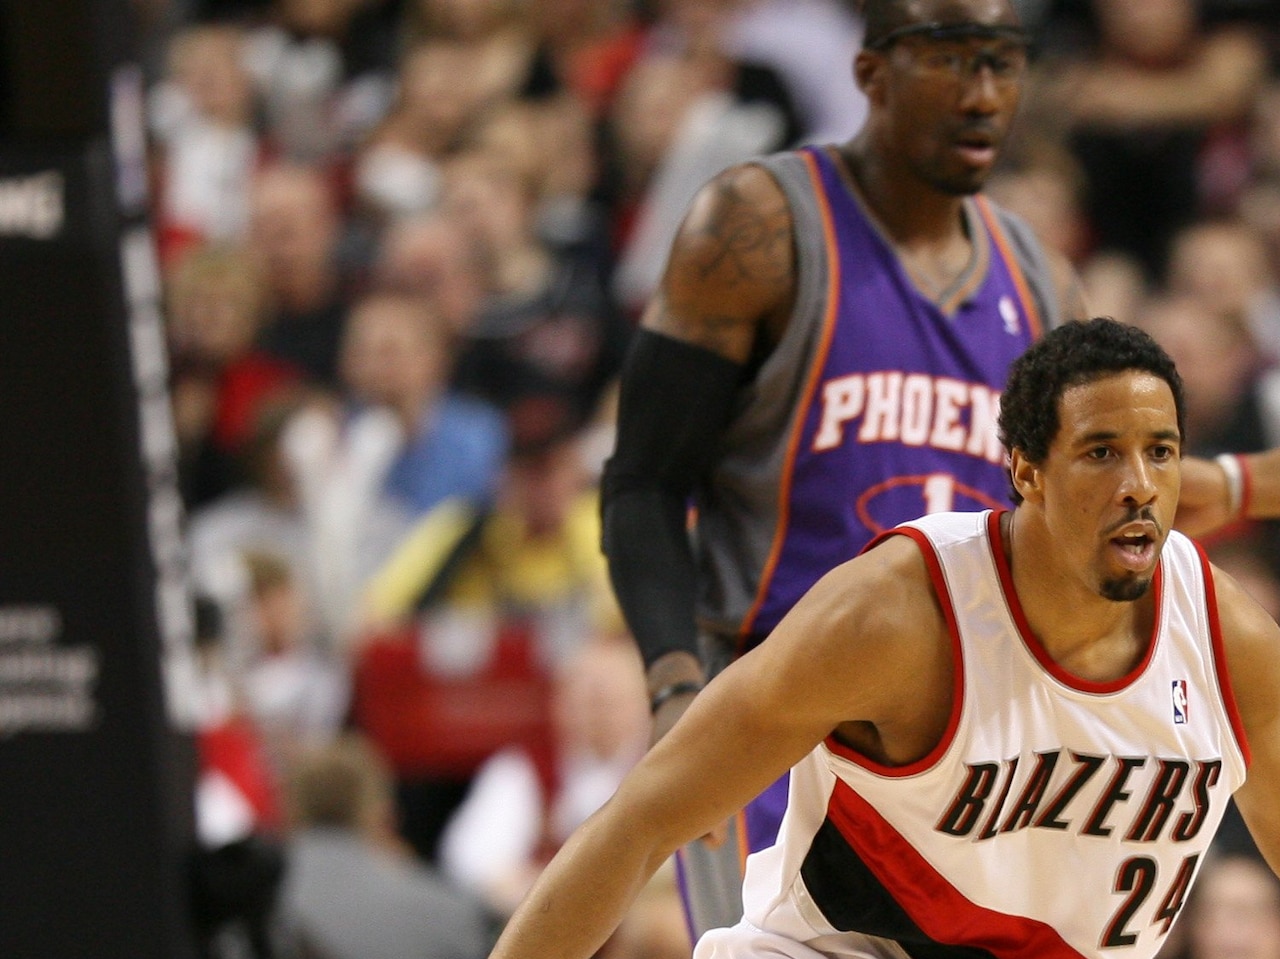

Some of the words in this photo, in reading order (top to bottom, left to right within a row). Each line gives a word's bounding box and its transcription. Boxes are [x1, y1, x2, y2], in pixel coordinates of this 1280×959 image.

[811, 370, 1011, 468] PHOEN
[932, 746, 1223, 844] BLAZERS
[1097, 852, 1200, 950] 24
